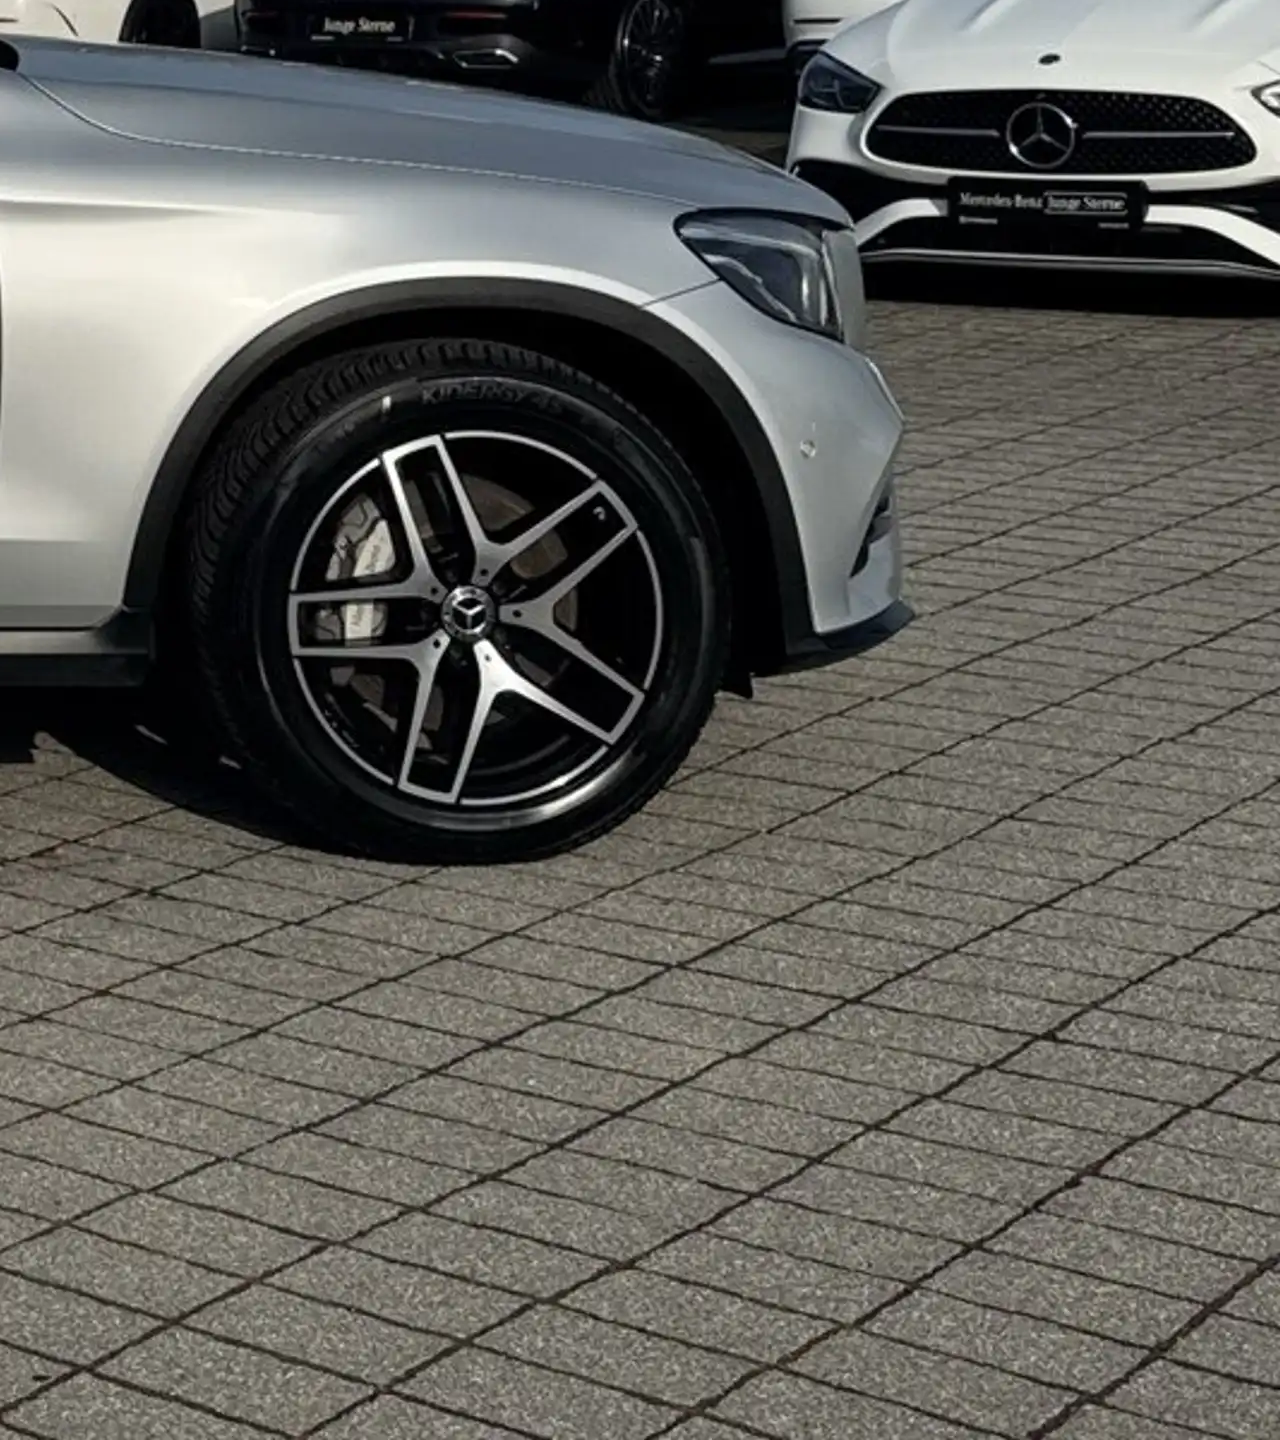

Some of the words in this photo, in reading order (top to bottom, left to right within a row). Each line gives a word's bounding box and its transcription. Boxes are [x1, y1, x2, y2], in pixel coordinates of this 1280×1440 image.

[323, 17, 356, 35] Junge
[358, 17, 396, 33] Sterne
[1047, 196, 1081, 211] Junge
[1083, 196, 1126, 211] Sterne
